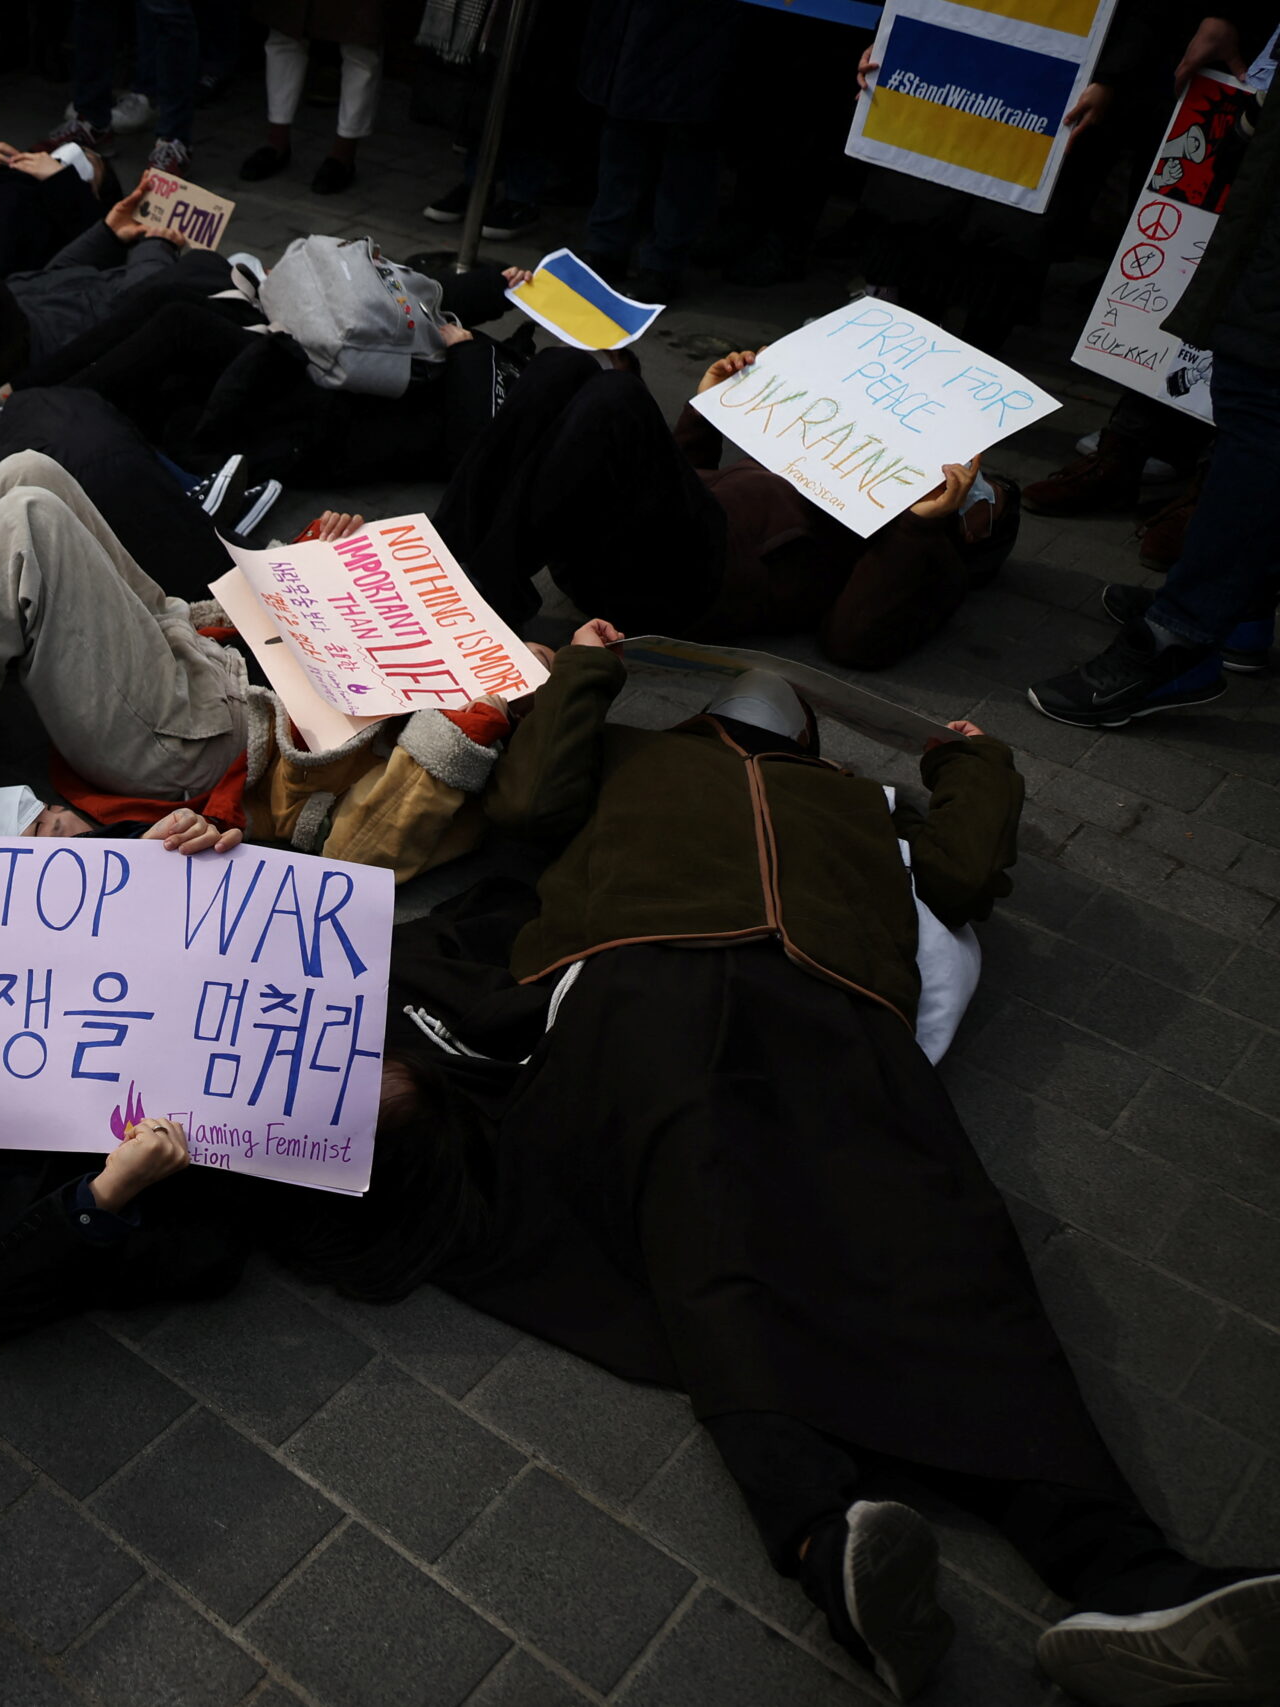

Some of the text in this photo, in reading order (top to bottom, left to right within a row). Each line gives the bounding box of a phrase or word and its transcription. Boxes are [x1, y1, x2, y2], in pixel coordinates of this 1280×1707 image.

[886, 68, 1048, 134] #StandWithUkraine
[150, 174, 178, 199] STOP
[167, 200, 224, 248] PUTIN
[1111, 282, 1168, 312] NÃO
[827, 308, 1034, 427] PRAY FOR
[1177, 349, 1200, 365] FEW
[842, 362, 946, 433] PEACE
[719, 366, 925, 508] UKRAINE
[778, 457, 846, 511] franciscan
[333, 535, 428, 637] IMPORTANT
[379, 525, 529, 695] NOTHING IS MORE
[324, 643, 360, 672] 중요한
[327, 592, 383, 639] THAN
[365, 639, 472, 702] LIFE
[185, 856, 368, 979] WAR
[194, 979, 381, 1126] 멈춰라
[187, 1147, 231, 1169] tion
[266, 1122, 352, 1163] Feminist
